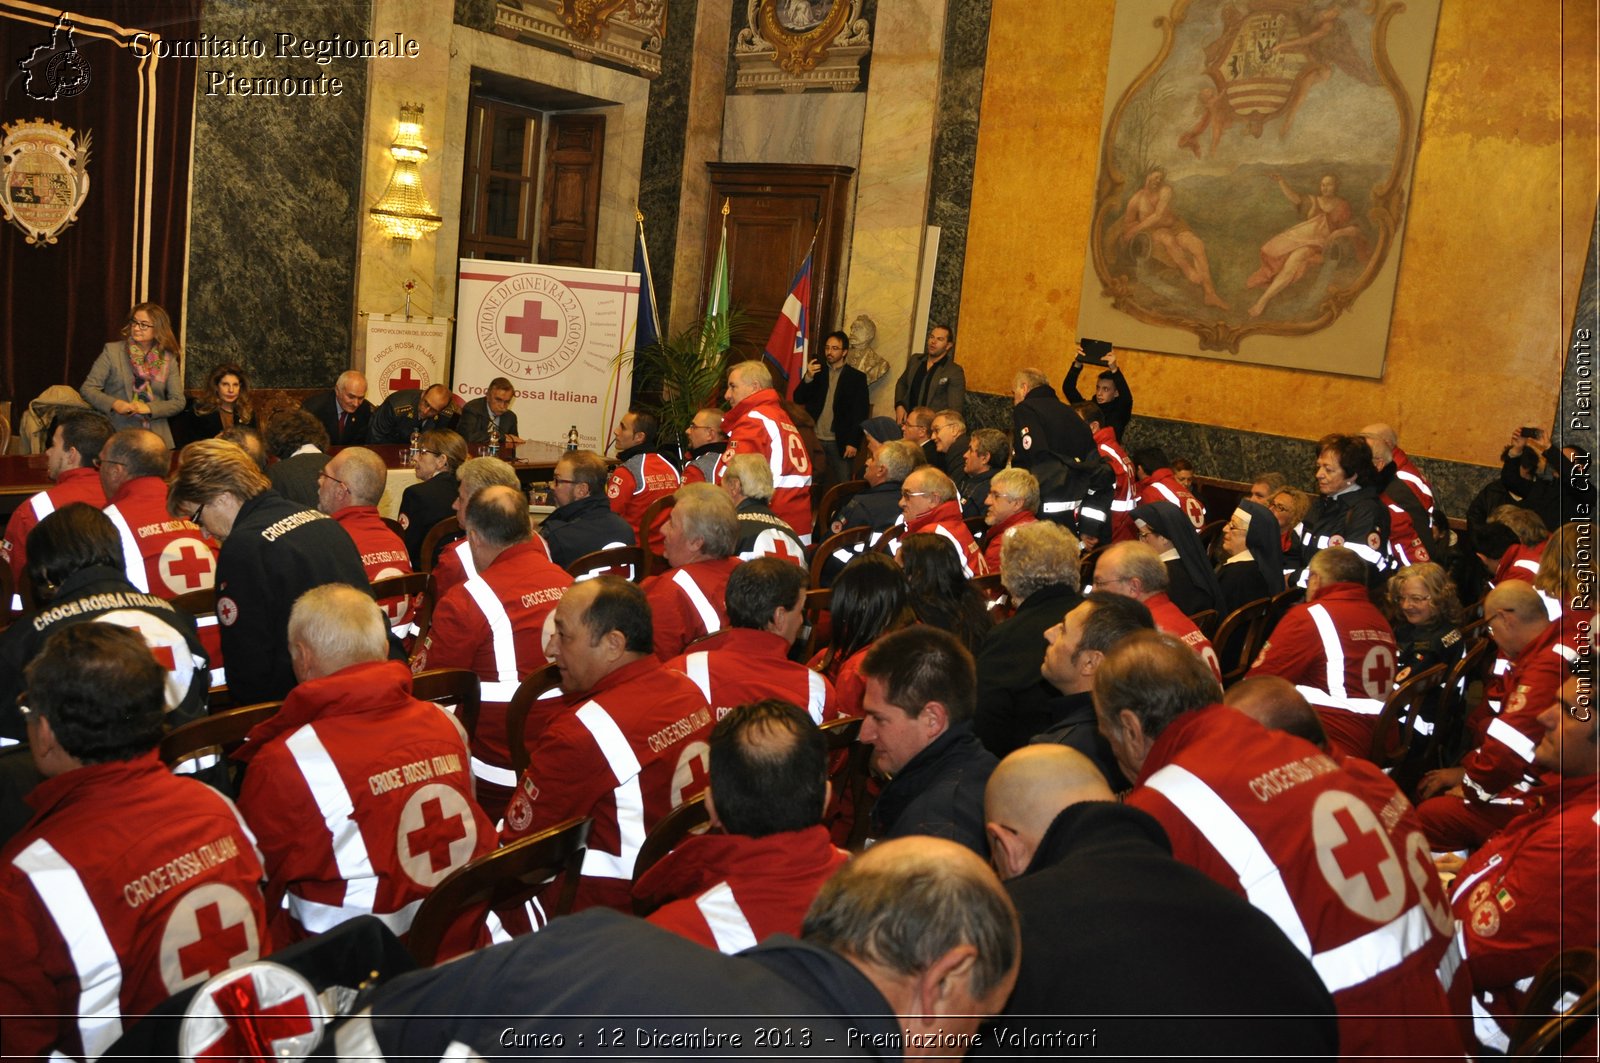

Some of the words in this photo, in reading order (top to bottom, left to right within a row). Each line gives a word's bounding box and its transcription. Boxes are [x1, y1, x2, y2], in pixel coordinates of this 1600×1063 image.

[497, 283, 512, 300] DI
[512, 277, 565, 301] GINEVRA
[562, 298, 577, 313] 22
[480, 296, 520, 374] CONVENZIONE
[559, 314, 582, 361] AGOSTO
[374, 345, 394, 363] CROCE
[394, 341, 415, 350] ROSSA
[415, 345, 437, 367] ITALIANA
[536, 357, 560, 375] 1864
[458, 383, 489, 395] Croc
[514, 388, 545, 400] ossa
[549, 390, 598, 404] Italiana
[261, 516, 297, 542] CROCE
[521, 590, 547, 608] CROCE
[543, 587, 564, 601] ROSSA
[33, 601, 82, 631] CROCE
[80, 592, 127, 612] ROSSA
[647, 726, 677, 753] CROCE
[671, 716, 694, 742] ROSSA
[368, 767, 404, 796] CROCE
[401, 759, 434, 785] ROSSA
[1248, 767, 1296, 802] CROCE
[124, 866, 171, 908] CROCE
[164, 850, 206, 889] ROSSA
